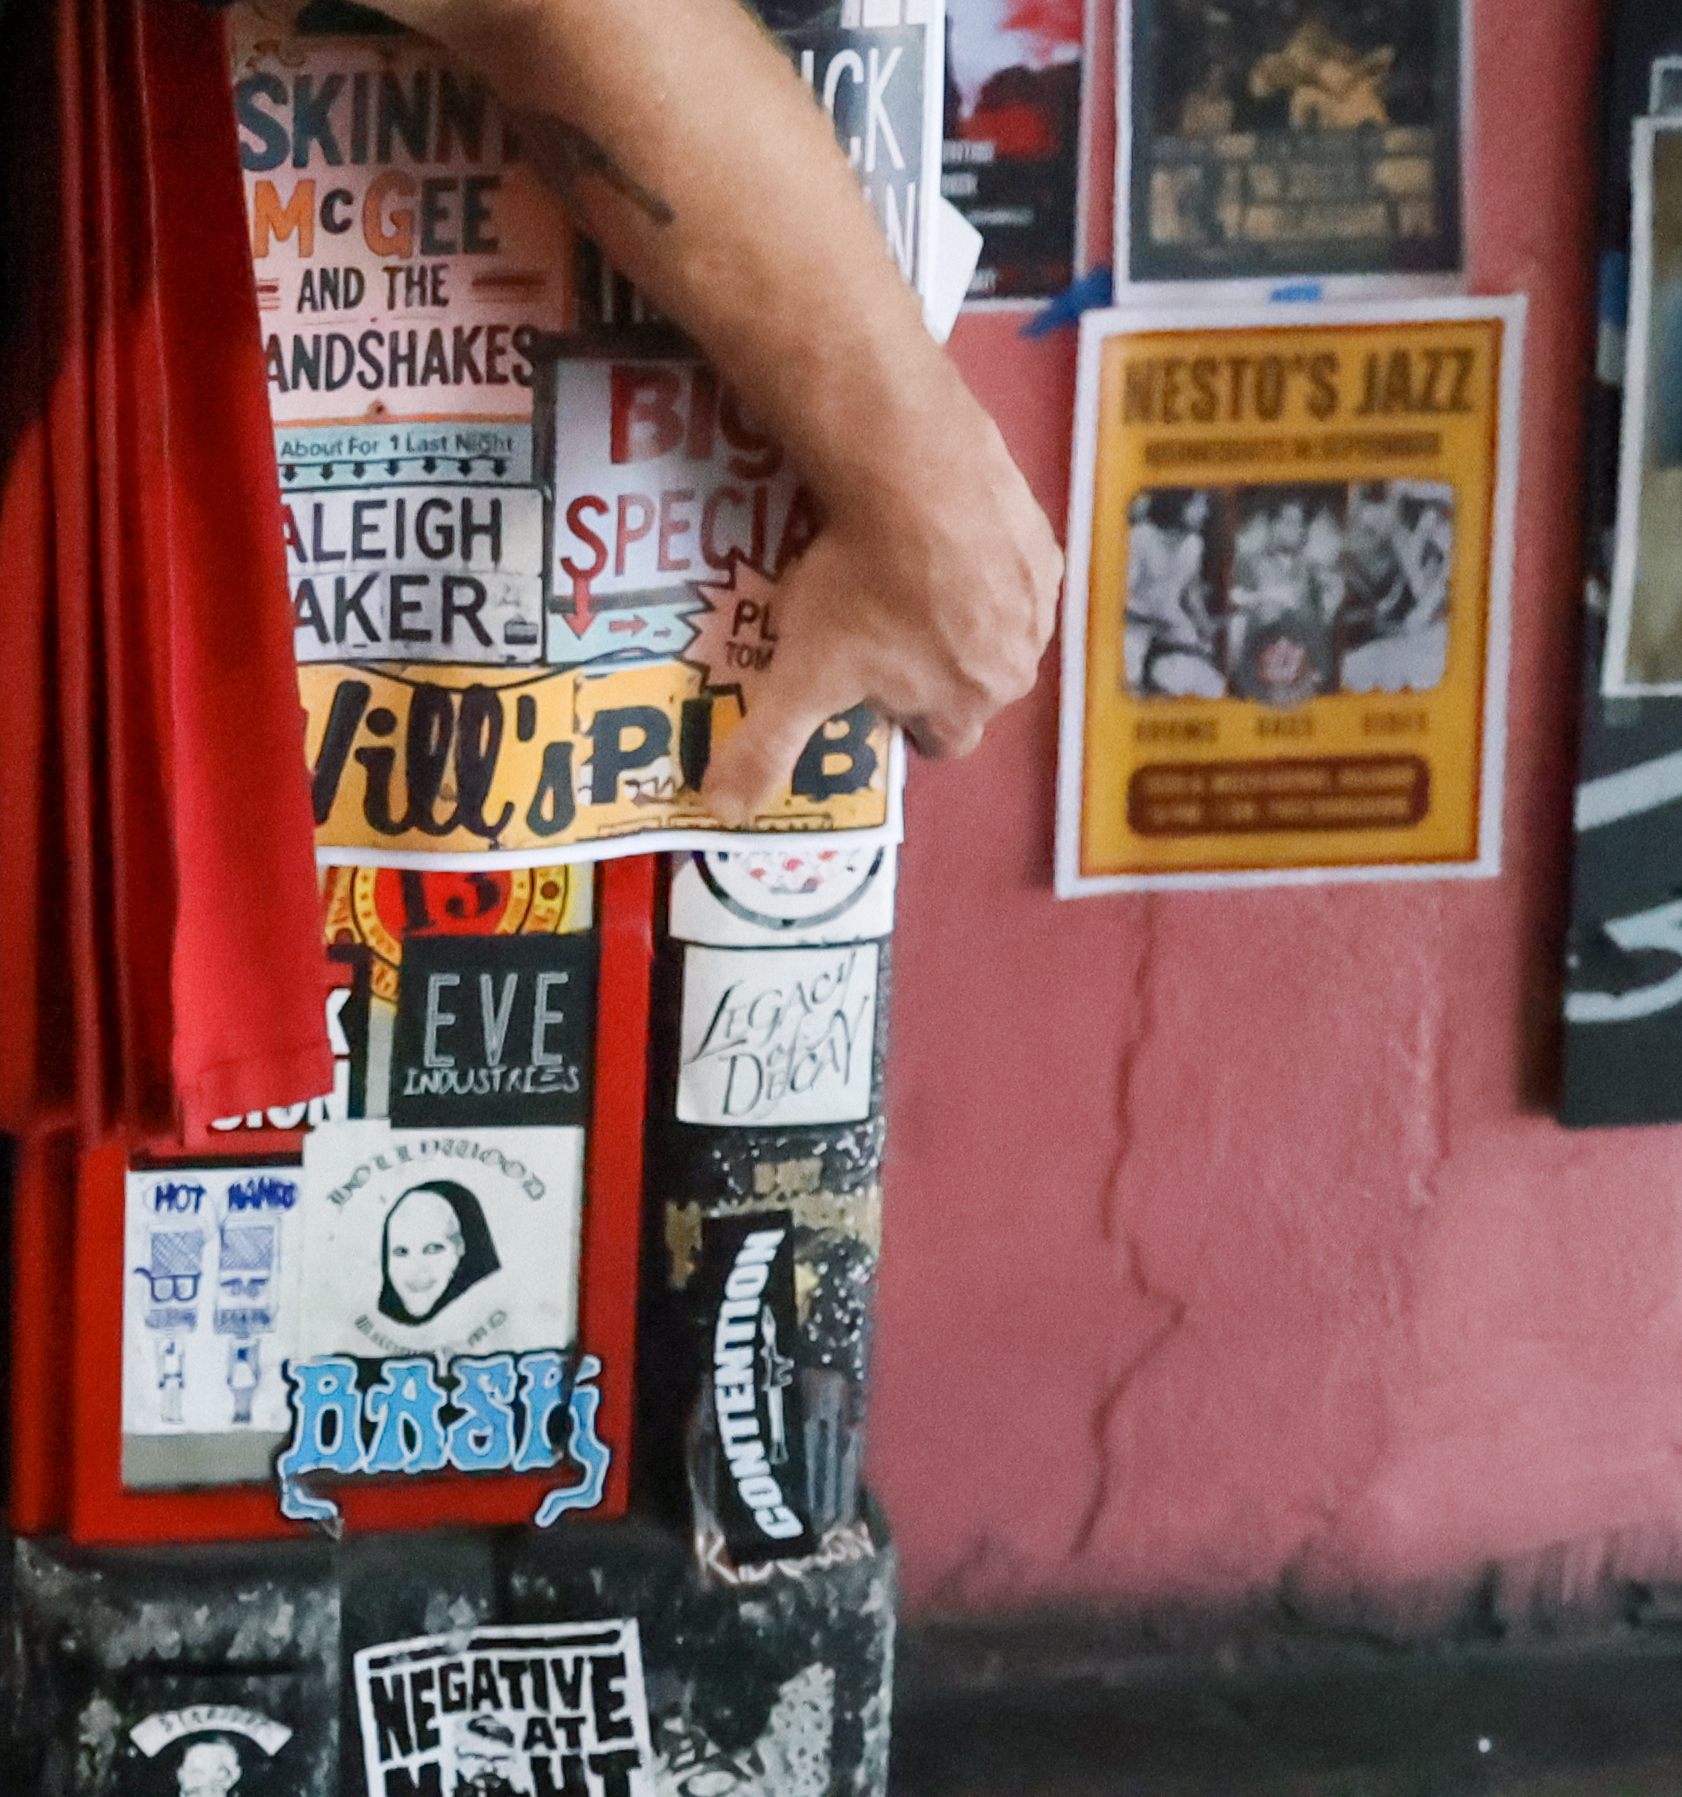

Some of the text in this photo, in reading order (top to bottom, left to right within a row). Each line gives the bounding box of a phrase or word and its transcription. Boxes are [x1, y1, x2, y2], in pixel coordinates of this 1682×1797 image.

[296, 263, 450, 314] AND THE
[264, 323, 535, 393] ANDSHAKES
[1358, 346, 1476, 417] JAZZ
[348, 435, 380, 455] For
[406, 434, 448, 455] Last
[453, 433, 515, 454] Night
[279, 496, 503, 564] ALEIGH
[292, 572, 491, 647] AKER
[423, 970, 569, 1071] EVE
[403, 1064, 582, 1097] INDUSTRIES
[713, 1228, 805, 1540] CONTENTION
[368, 1653, 637, 1762] NEGATIVE
[521, 1715, 588, 1752] AT
